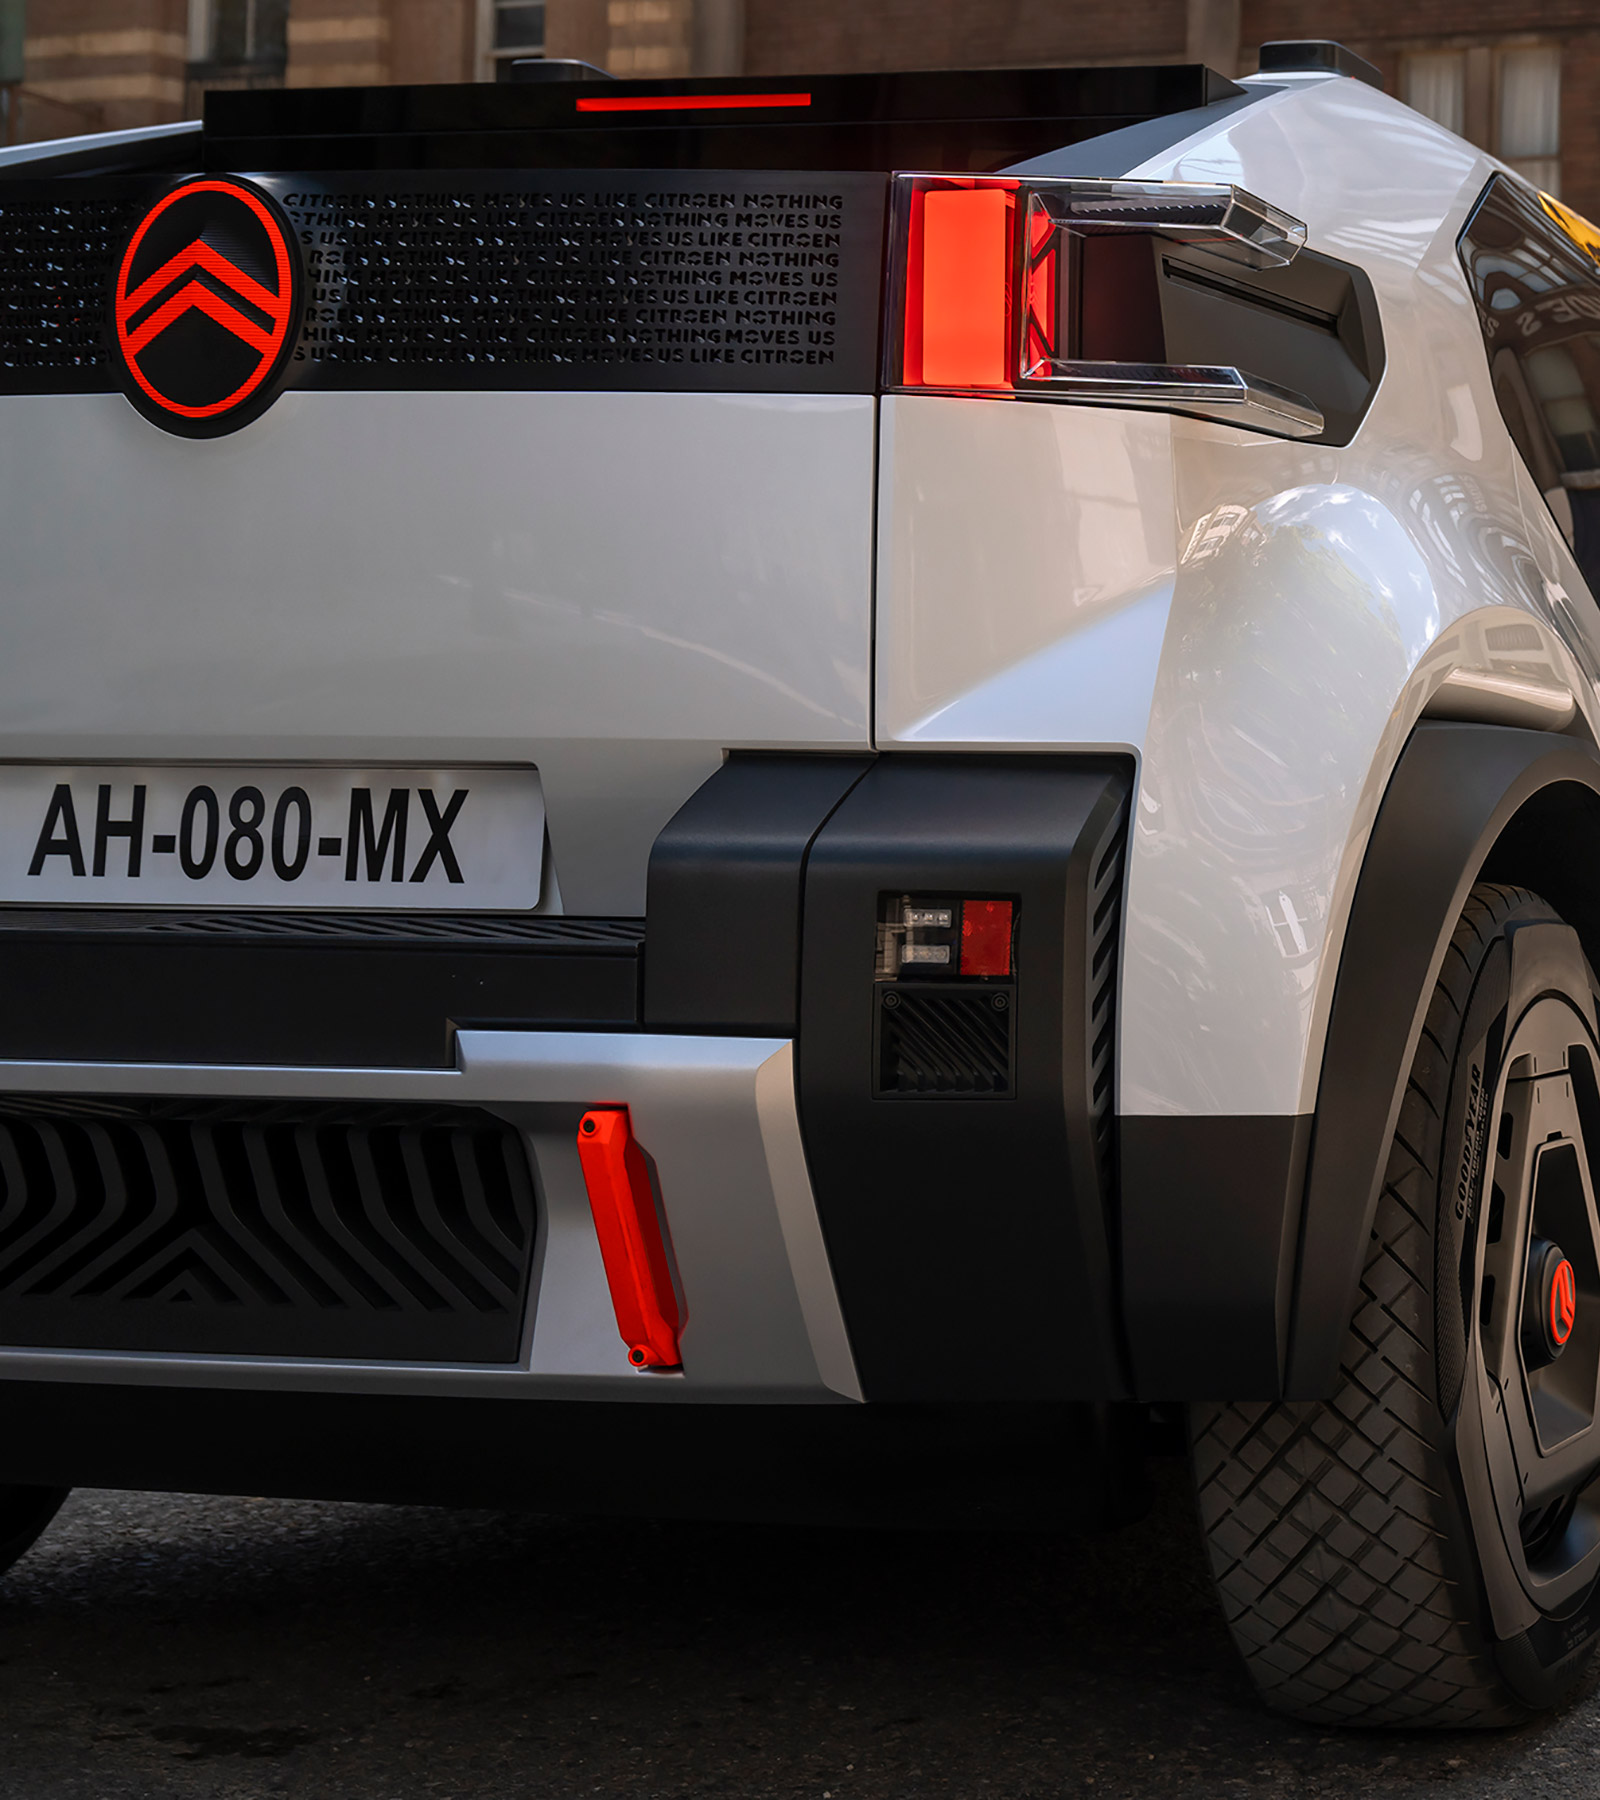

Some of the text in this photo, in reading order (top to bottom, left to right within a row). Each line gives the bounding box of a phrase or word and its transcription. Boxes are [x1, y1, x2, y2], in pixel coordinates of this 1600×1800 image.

[644, 194, 735, 209] CITROEN
[744, 194, 843, 209] NOTHING
[630, 213, 728, 228] NOTHING
[735, 214, 809, 229] MOVES
[815, 214, 841, 229] US
[590, 232, 661, 247] MOVES
[667, 233, 693, 247] US
[699, 233, 742, 247] LIKE
[748, 233, 840, 248] CITROEN
[640, 252, 730, 267] CITROEN
[739, 252, 839, 267] NOTHING
[623, 271, 722, 286] NOTHING
[729, 272, 803, 286] MOVES
[811, 272, 838, 287] US
[585, 290, 658, 304] MOVES
[663, 291, 689, 305] US
[694, 291, 738, 305] LIKE
[744, 291, 837, 306] CITROEN
[635, 310, 727, 324] CITROEN
[735, 311, 836, 325] NOTHING
[622, 329, 721, 344] NOTHING
[725, 330, 799, 345] MOVES
[808, 330, 835, 345] US
[658, 349, 684, 363] US
[690, 349, 735, 364] LIKE
[741, 350, 834, 364] CITROEN
[27, 783, 470, 884] AH-080-MX
[1455, 1063, 1482, 1222] GOODYEAR
